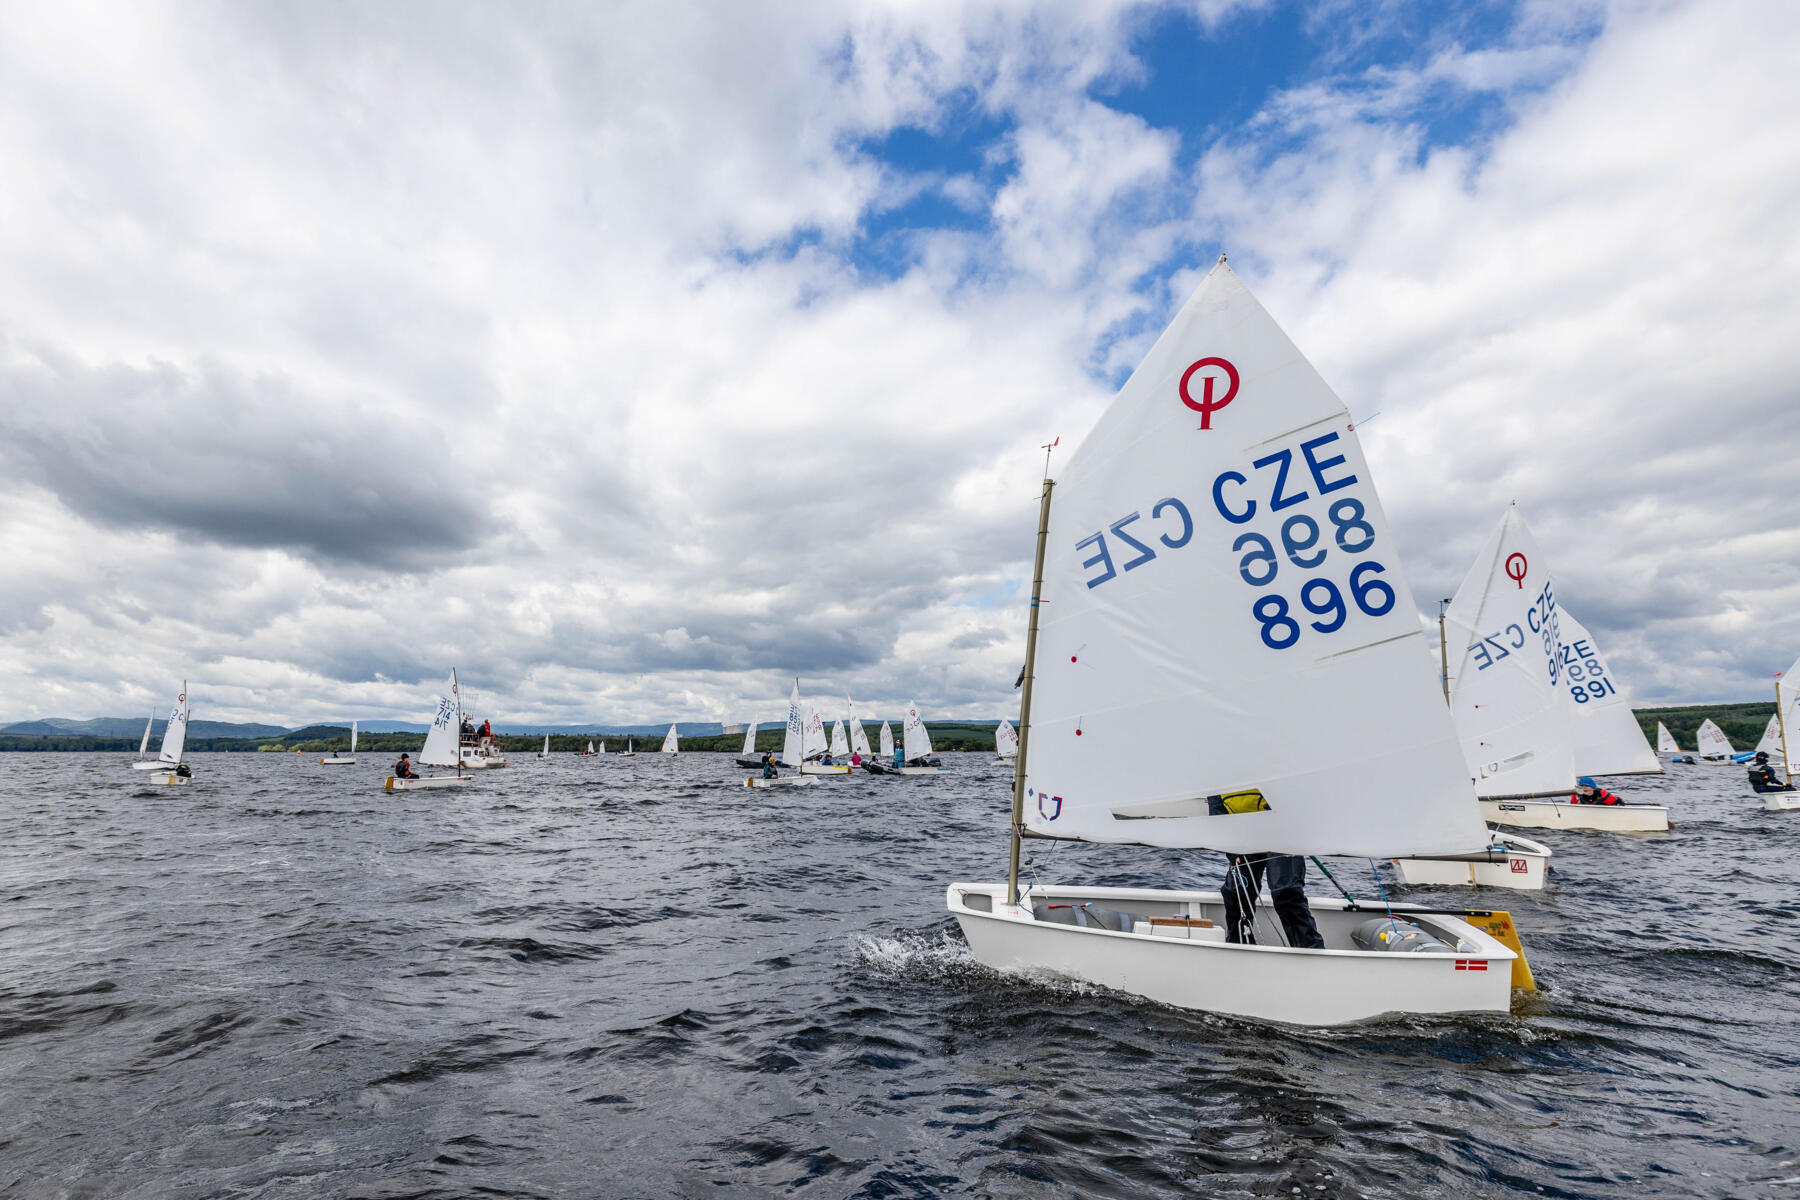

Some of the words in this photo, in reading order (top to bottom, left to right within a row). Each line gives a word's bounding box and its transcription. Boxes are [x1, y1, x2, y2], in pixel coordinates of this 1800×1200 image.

[1212, 431, 1358, 524] CZE
[1252, 561, 1395, 650] 896
[1528, 581, 1555, 633] CZE
[1562, 639, 1595, 665] ZE
[1570, 677, 1616, 703] 891
